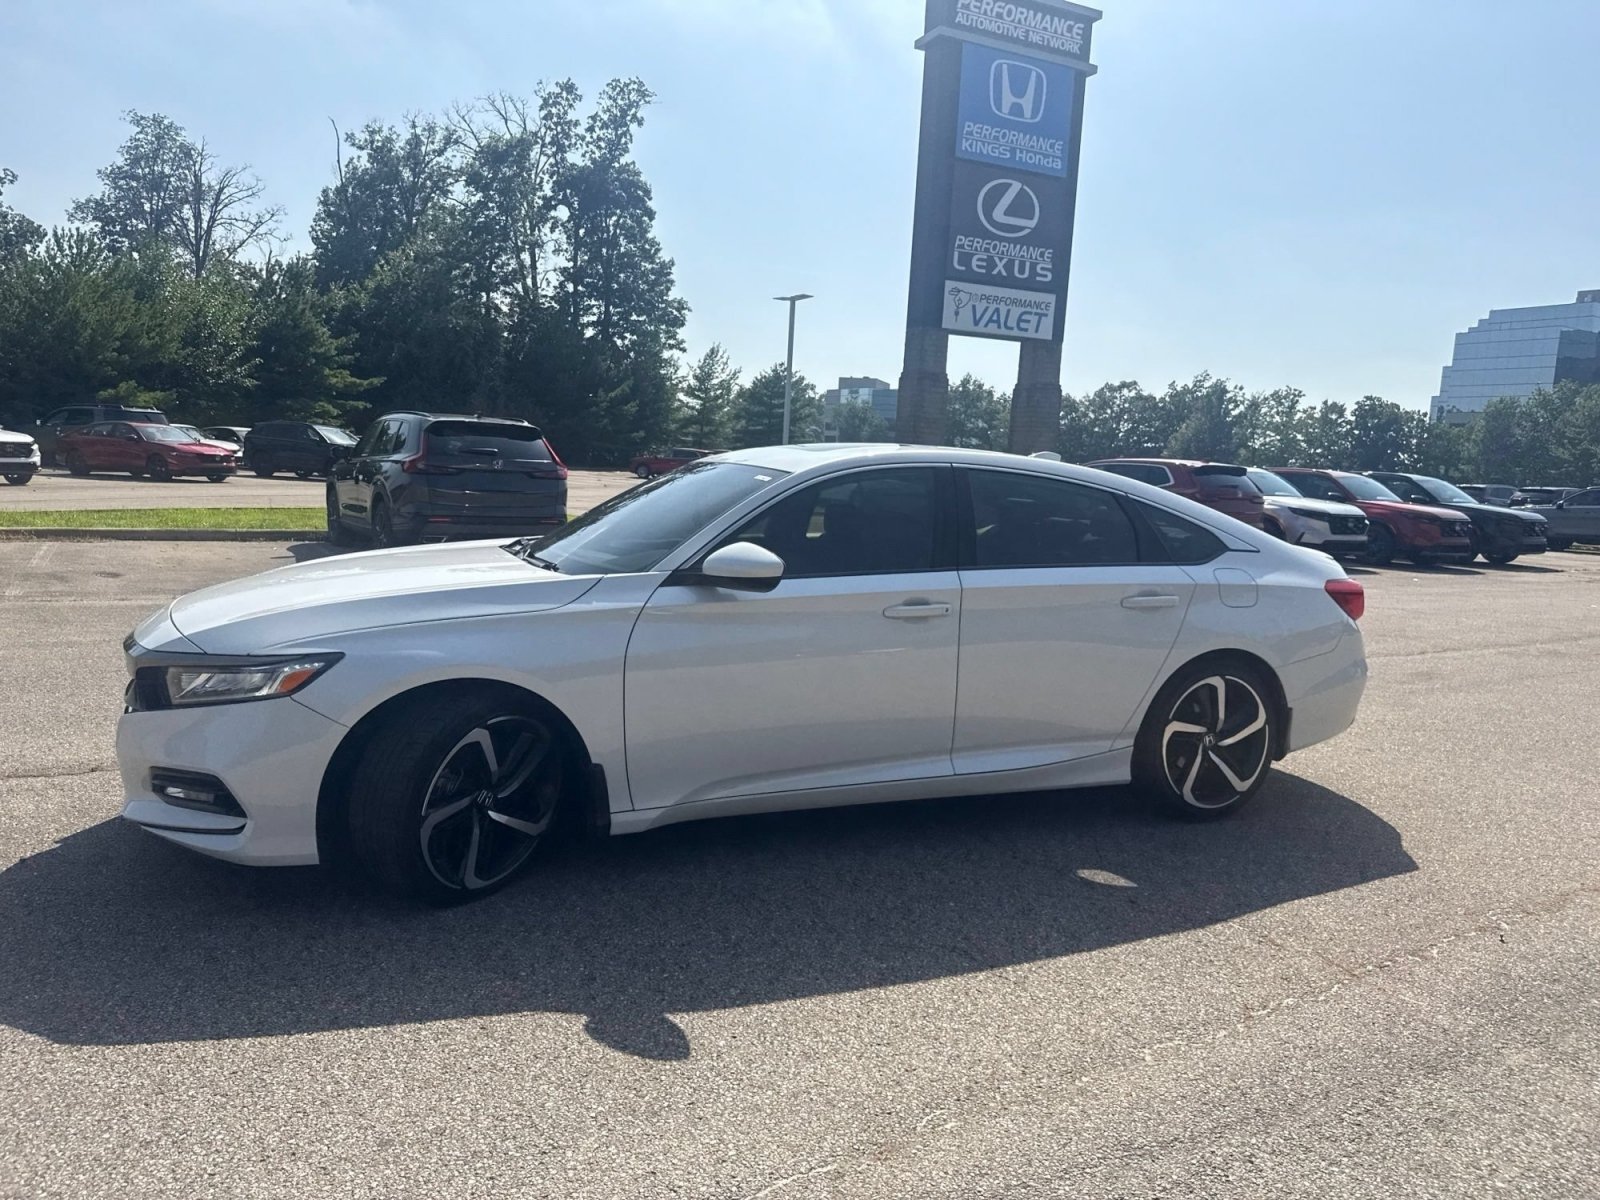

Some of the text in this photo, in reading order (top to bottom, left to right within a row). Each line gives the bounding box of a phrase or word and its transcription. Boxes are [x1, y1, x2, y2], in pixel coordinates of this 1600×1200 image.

[955, 13, 1081, 54] AUTOMOTIVE NETWORK
[957, 0, 1084, 40] PERFORMANCE
[961, 138, 1062, 169] KINGS Honda
[963, 121, 1064, 155] PERFORMANCE
[954, 235, 1054, 262] PERFORMANCE
[952, 251, 1053, 282] LEXUS
[979, 293, 1052, 312] PERFORMANCE
[971, 303, 1049, 334] VALET
